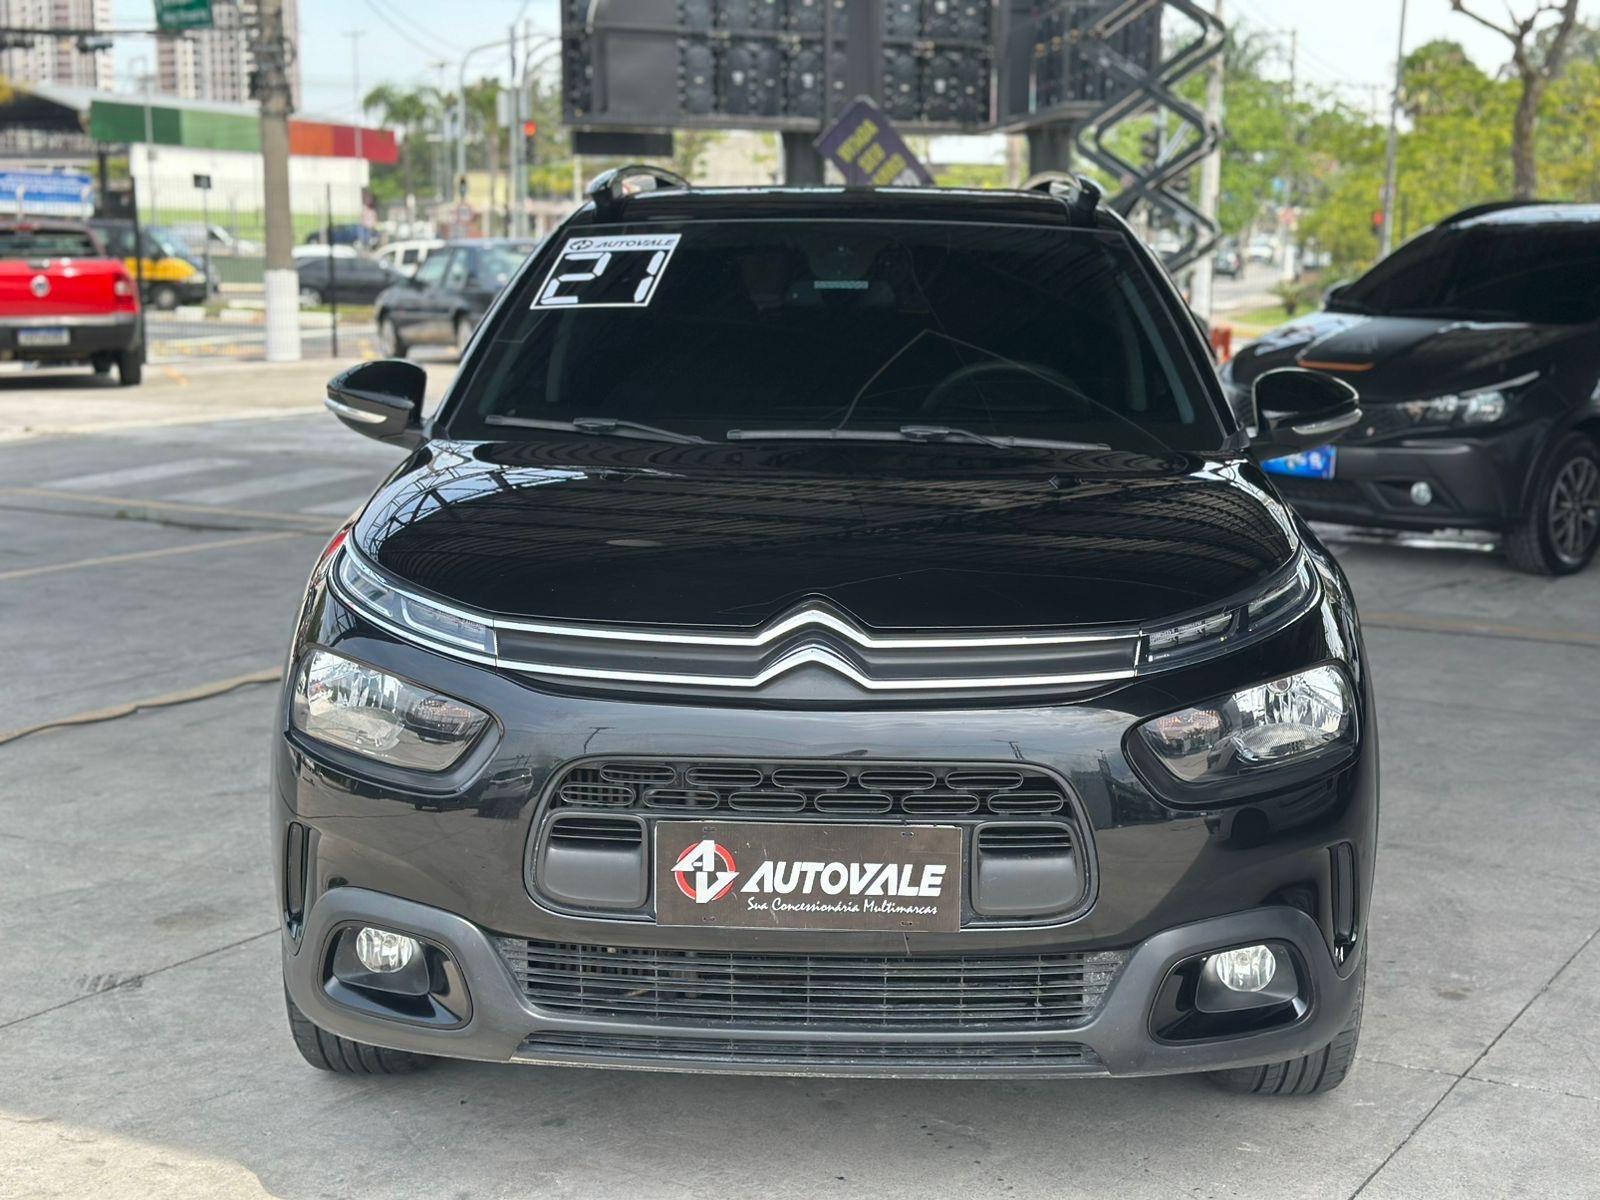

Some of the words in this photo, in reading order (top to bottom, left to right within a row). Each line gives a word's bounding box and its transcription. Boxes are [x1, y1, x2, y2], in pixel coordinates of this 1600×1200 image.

[595, 238, 675, 249] AUTOVALE
[540, 250, 665, 305] 21
[740, 860, 947, 897] AUTOVALE
[747, 896, 769, 911] Sua
[771, 897, 860, 912] Concessionária
[863, 899, 938, 915] Multimarcas
